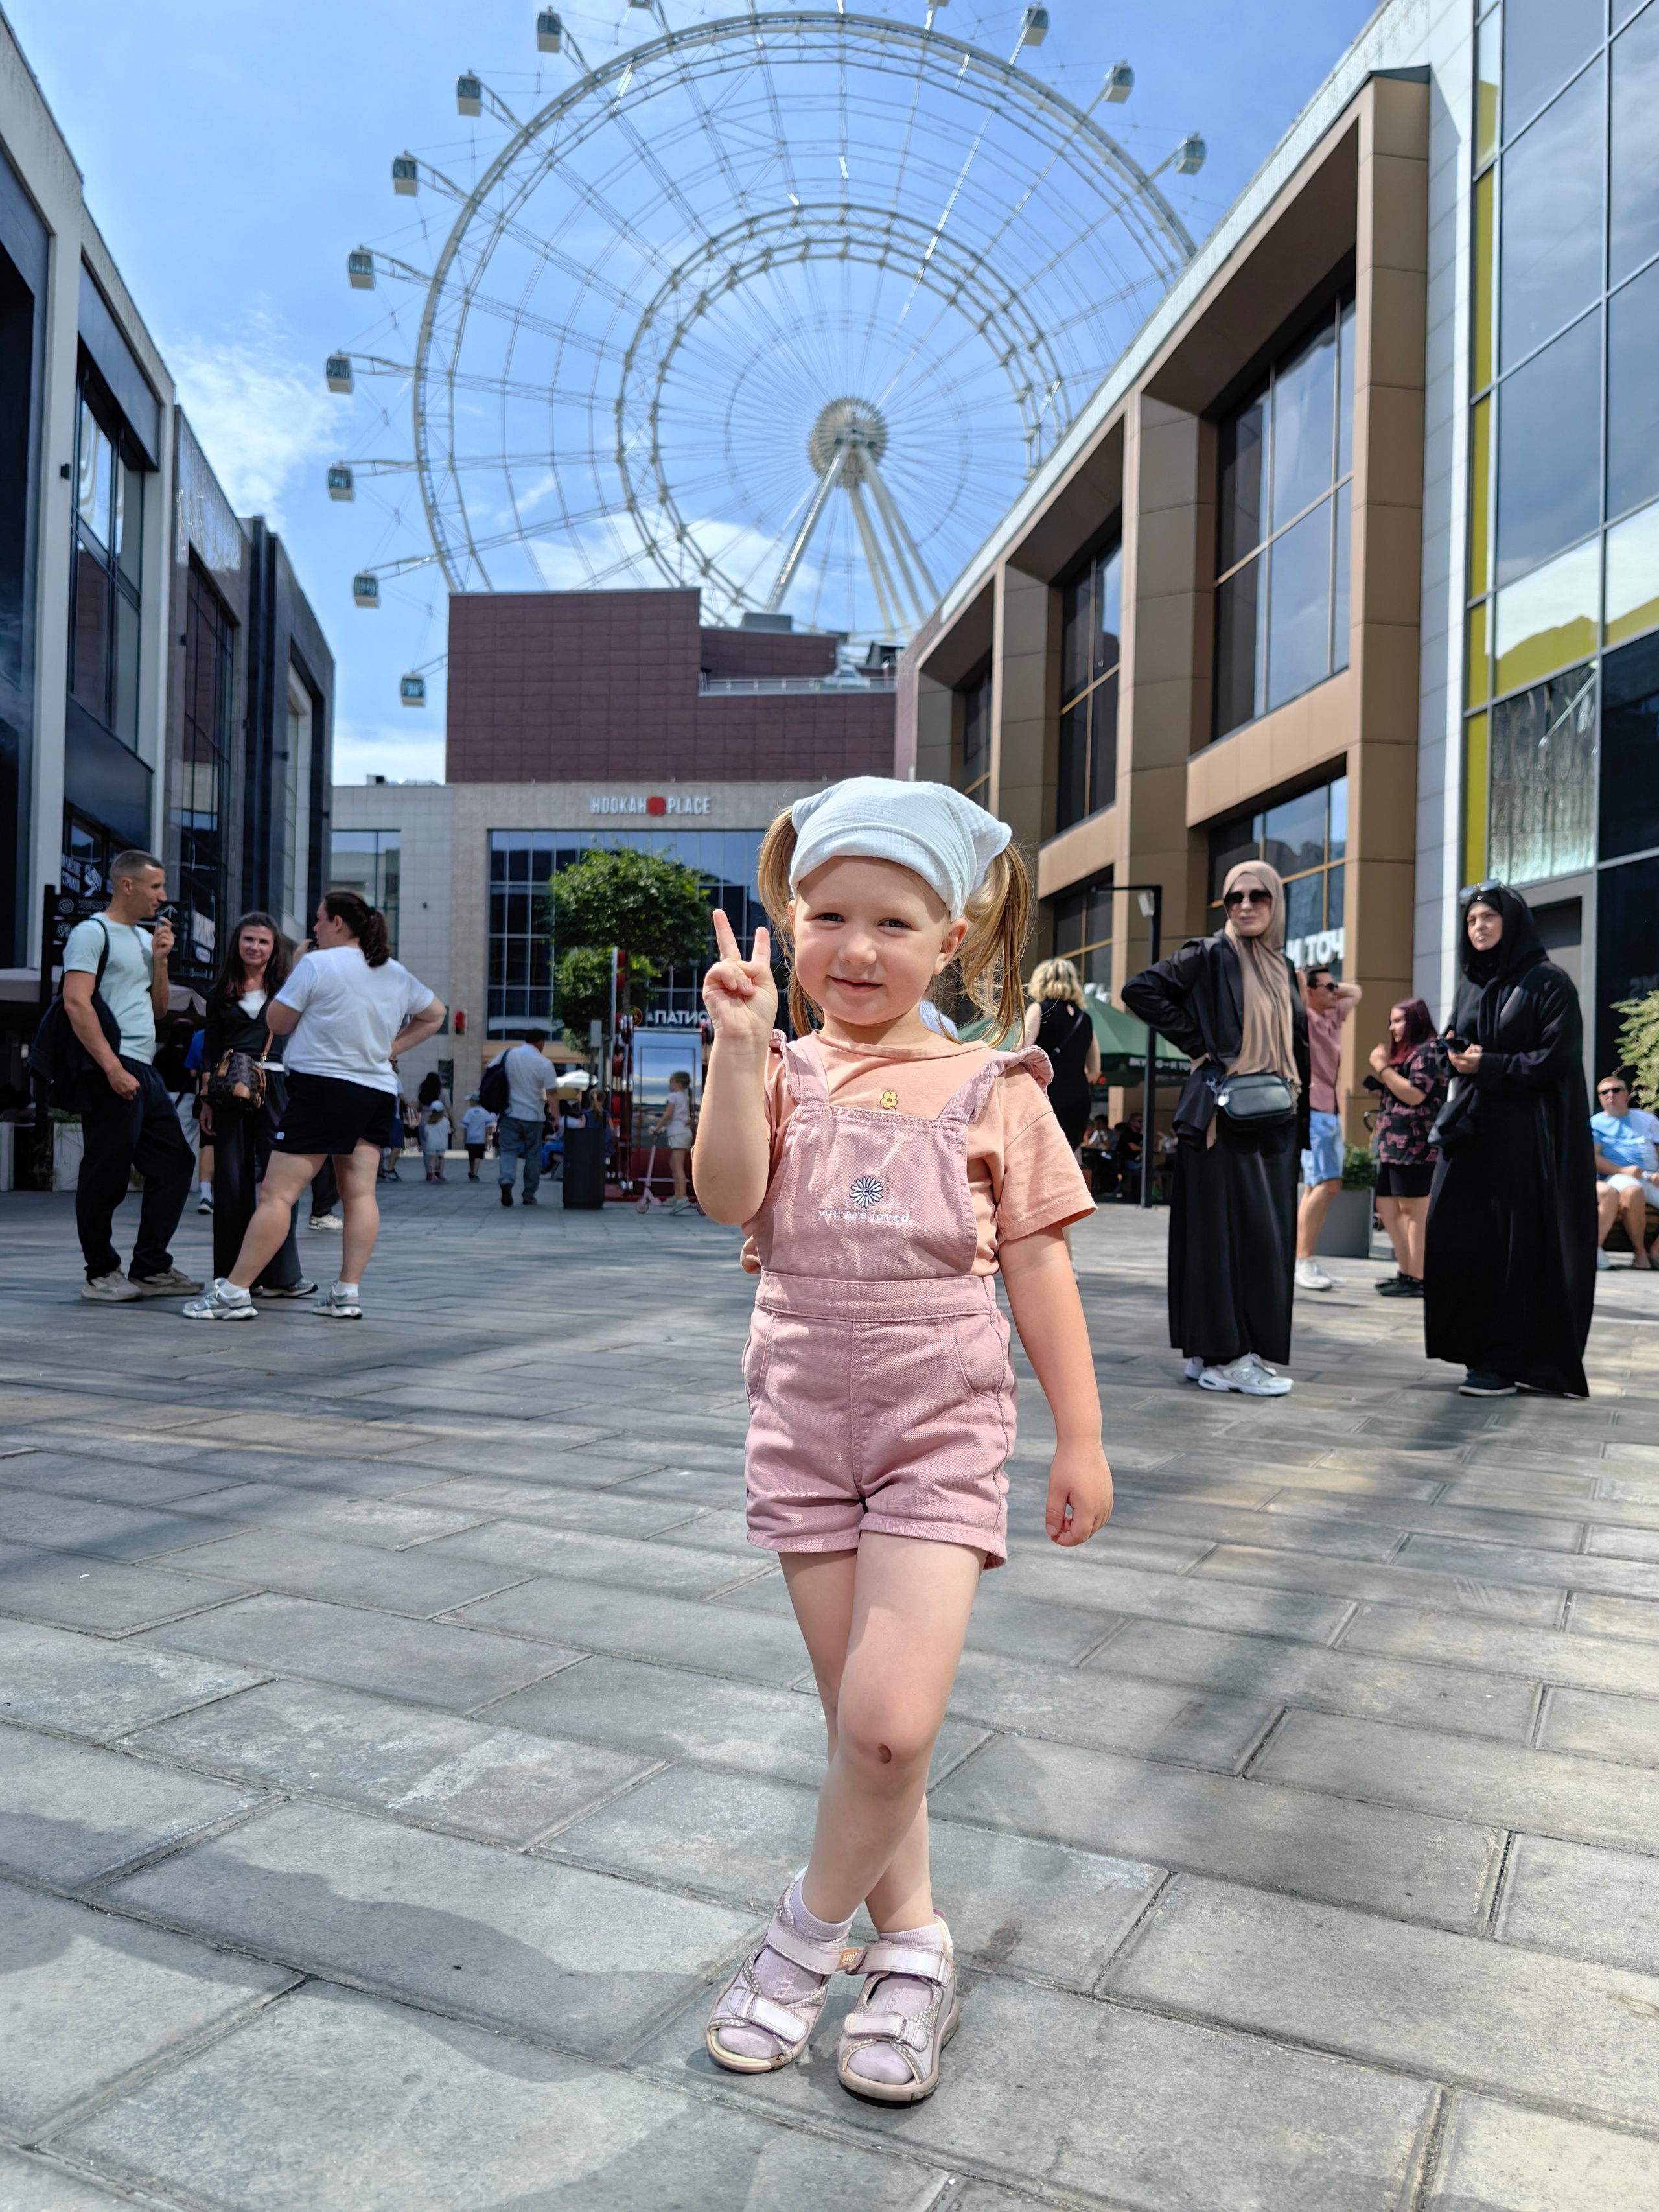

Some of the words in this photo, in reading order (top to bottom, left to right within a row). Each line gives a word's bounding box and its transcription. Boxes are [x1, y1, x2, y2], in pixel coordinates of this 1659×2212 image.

[590, 797, 647, 815] HOOKAH
[667, 797, 711, 815] PLACE
[817, 1209, 841, 1220] you
[844, 1211, 868, 1220] are
[870, 1211, 909, 1223] loved
